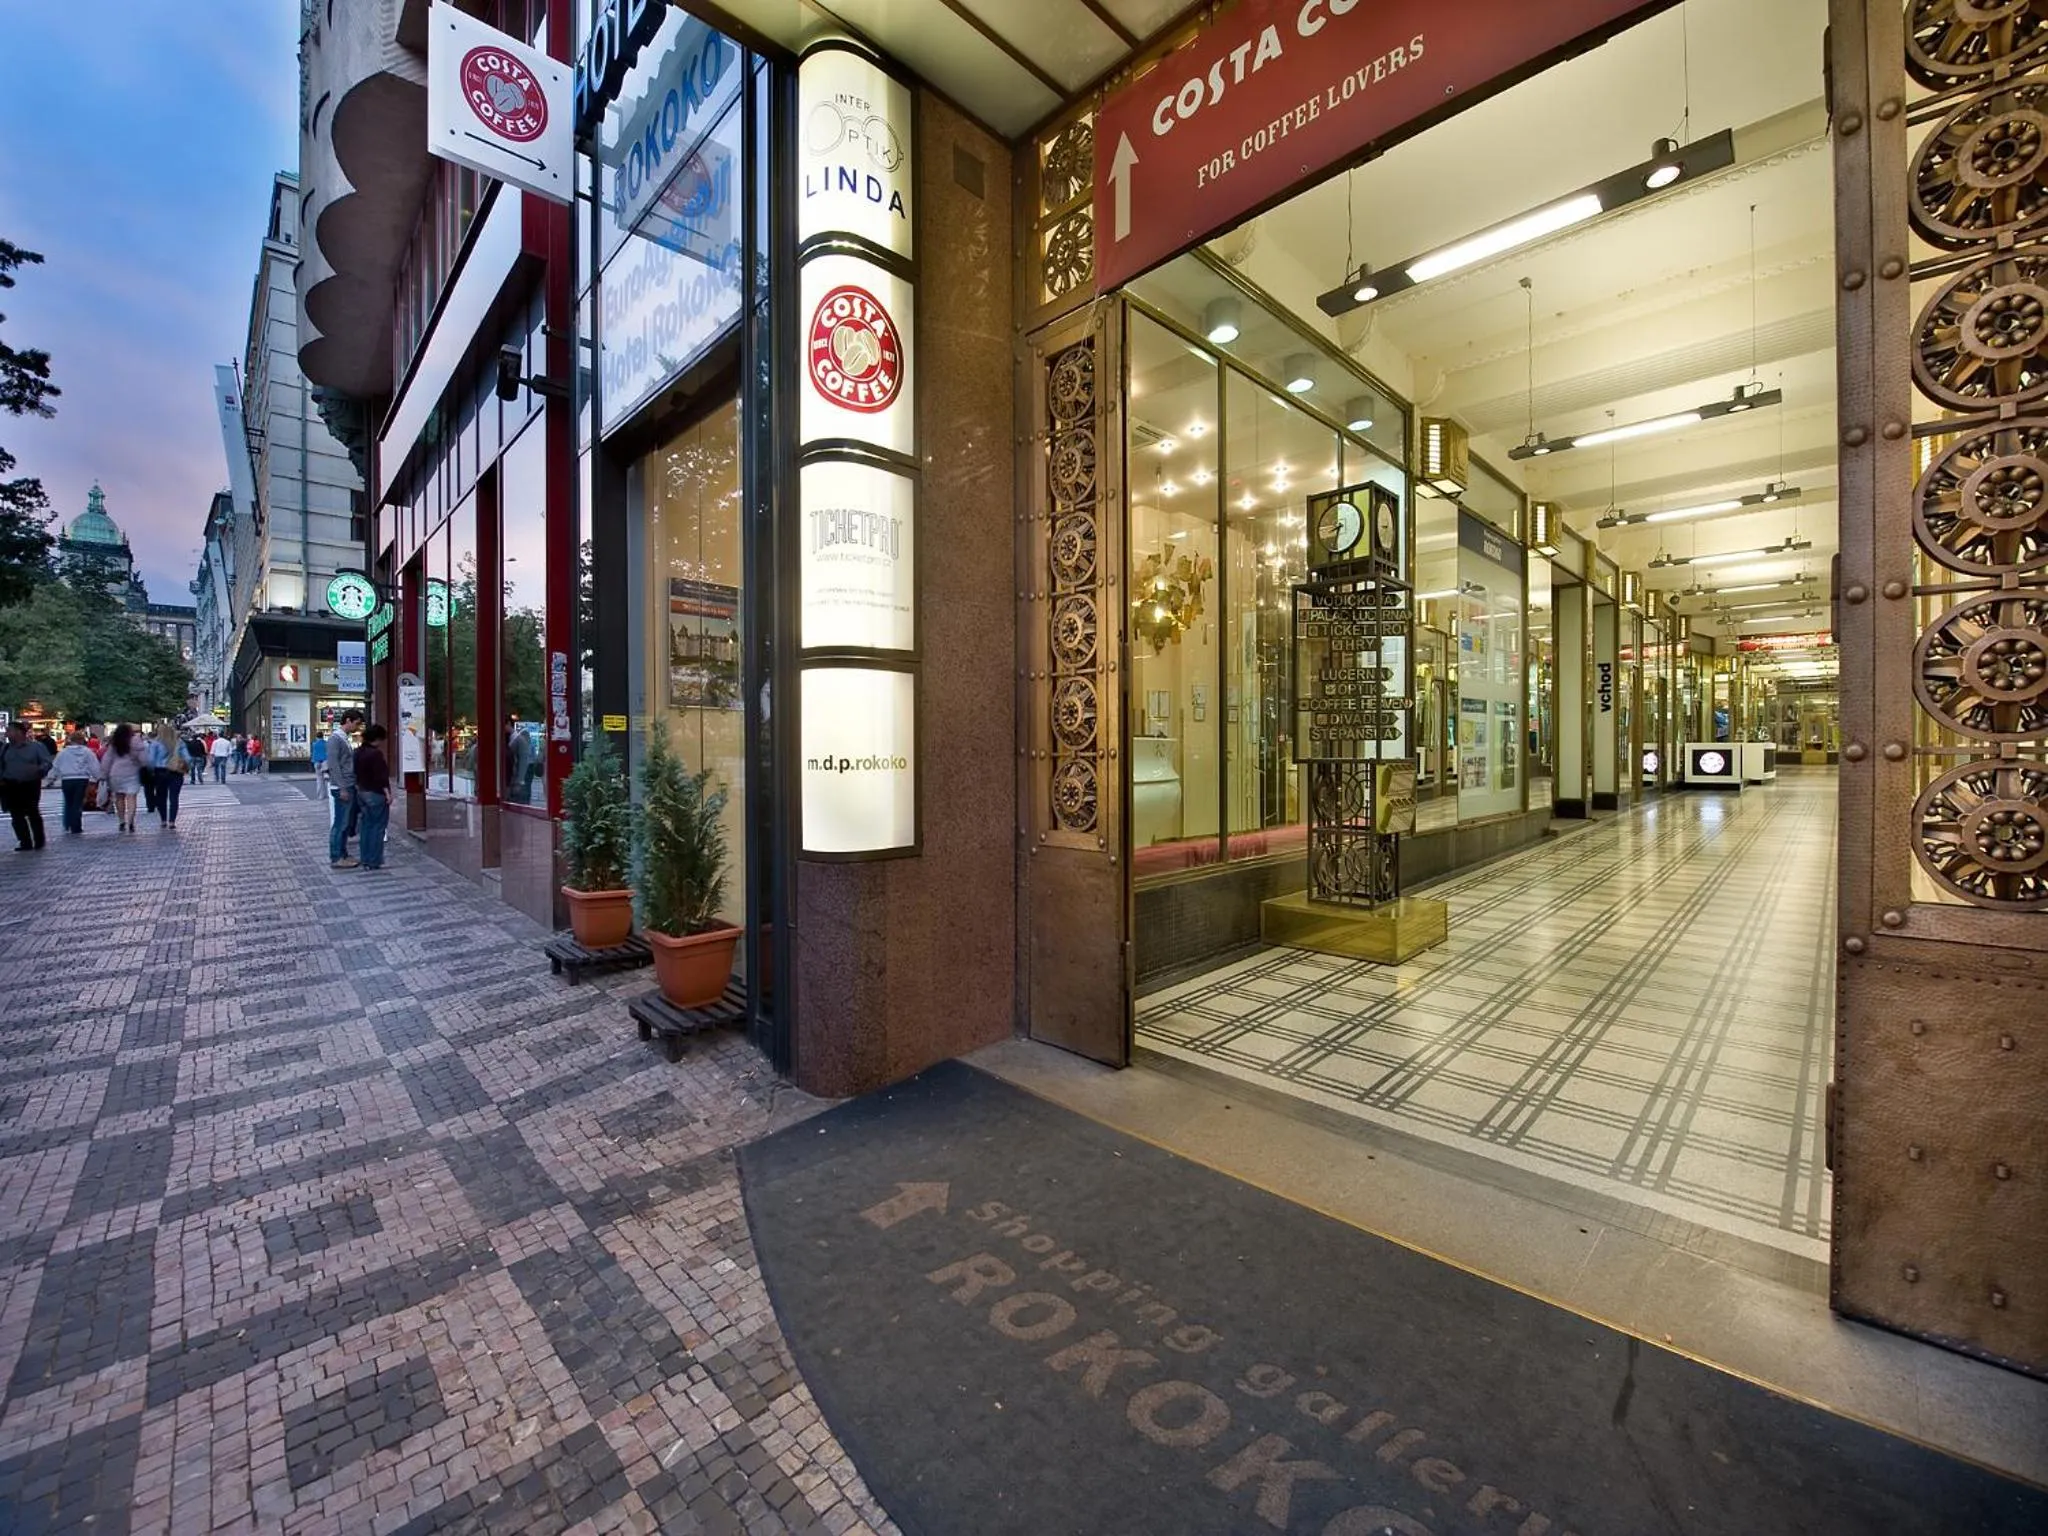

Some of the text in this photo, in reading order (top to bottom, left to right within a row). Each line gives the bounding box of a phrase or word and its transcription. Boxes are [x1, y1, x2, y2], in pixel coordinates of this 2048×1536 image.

[477, 55, 531, 92] COSTA
[1152, 24, 1283, 137] COSTA
[472, 90, 537, 133] COFFEE
[835, 93, 871, 112] INTER
[1198, 34, 1425, 189] FOR COFFEE LOVERS
[806, 165, 906, 219] LINDA
[821, 297, 886, 338] COSTA
[817, 358, 894, 402] COFFEE
[1353, 610, 1409, 621] LUCRNA
[1311, 699, 1357, 710] COFFEE
[1597, 663, 1611, 713] vchod
[807, 754, 907, 774] m.d.p.rokoko
[965, 1201, 1224, 1354] Shopping
